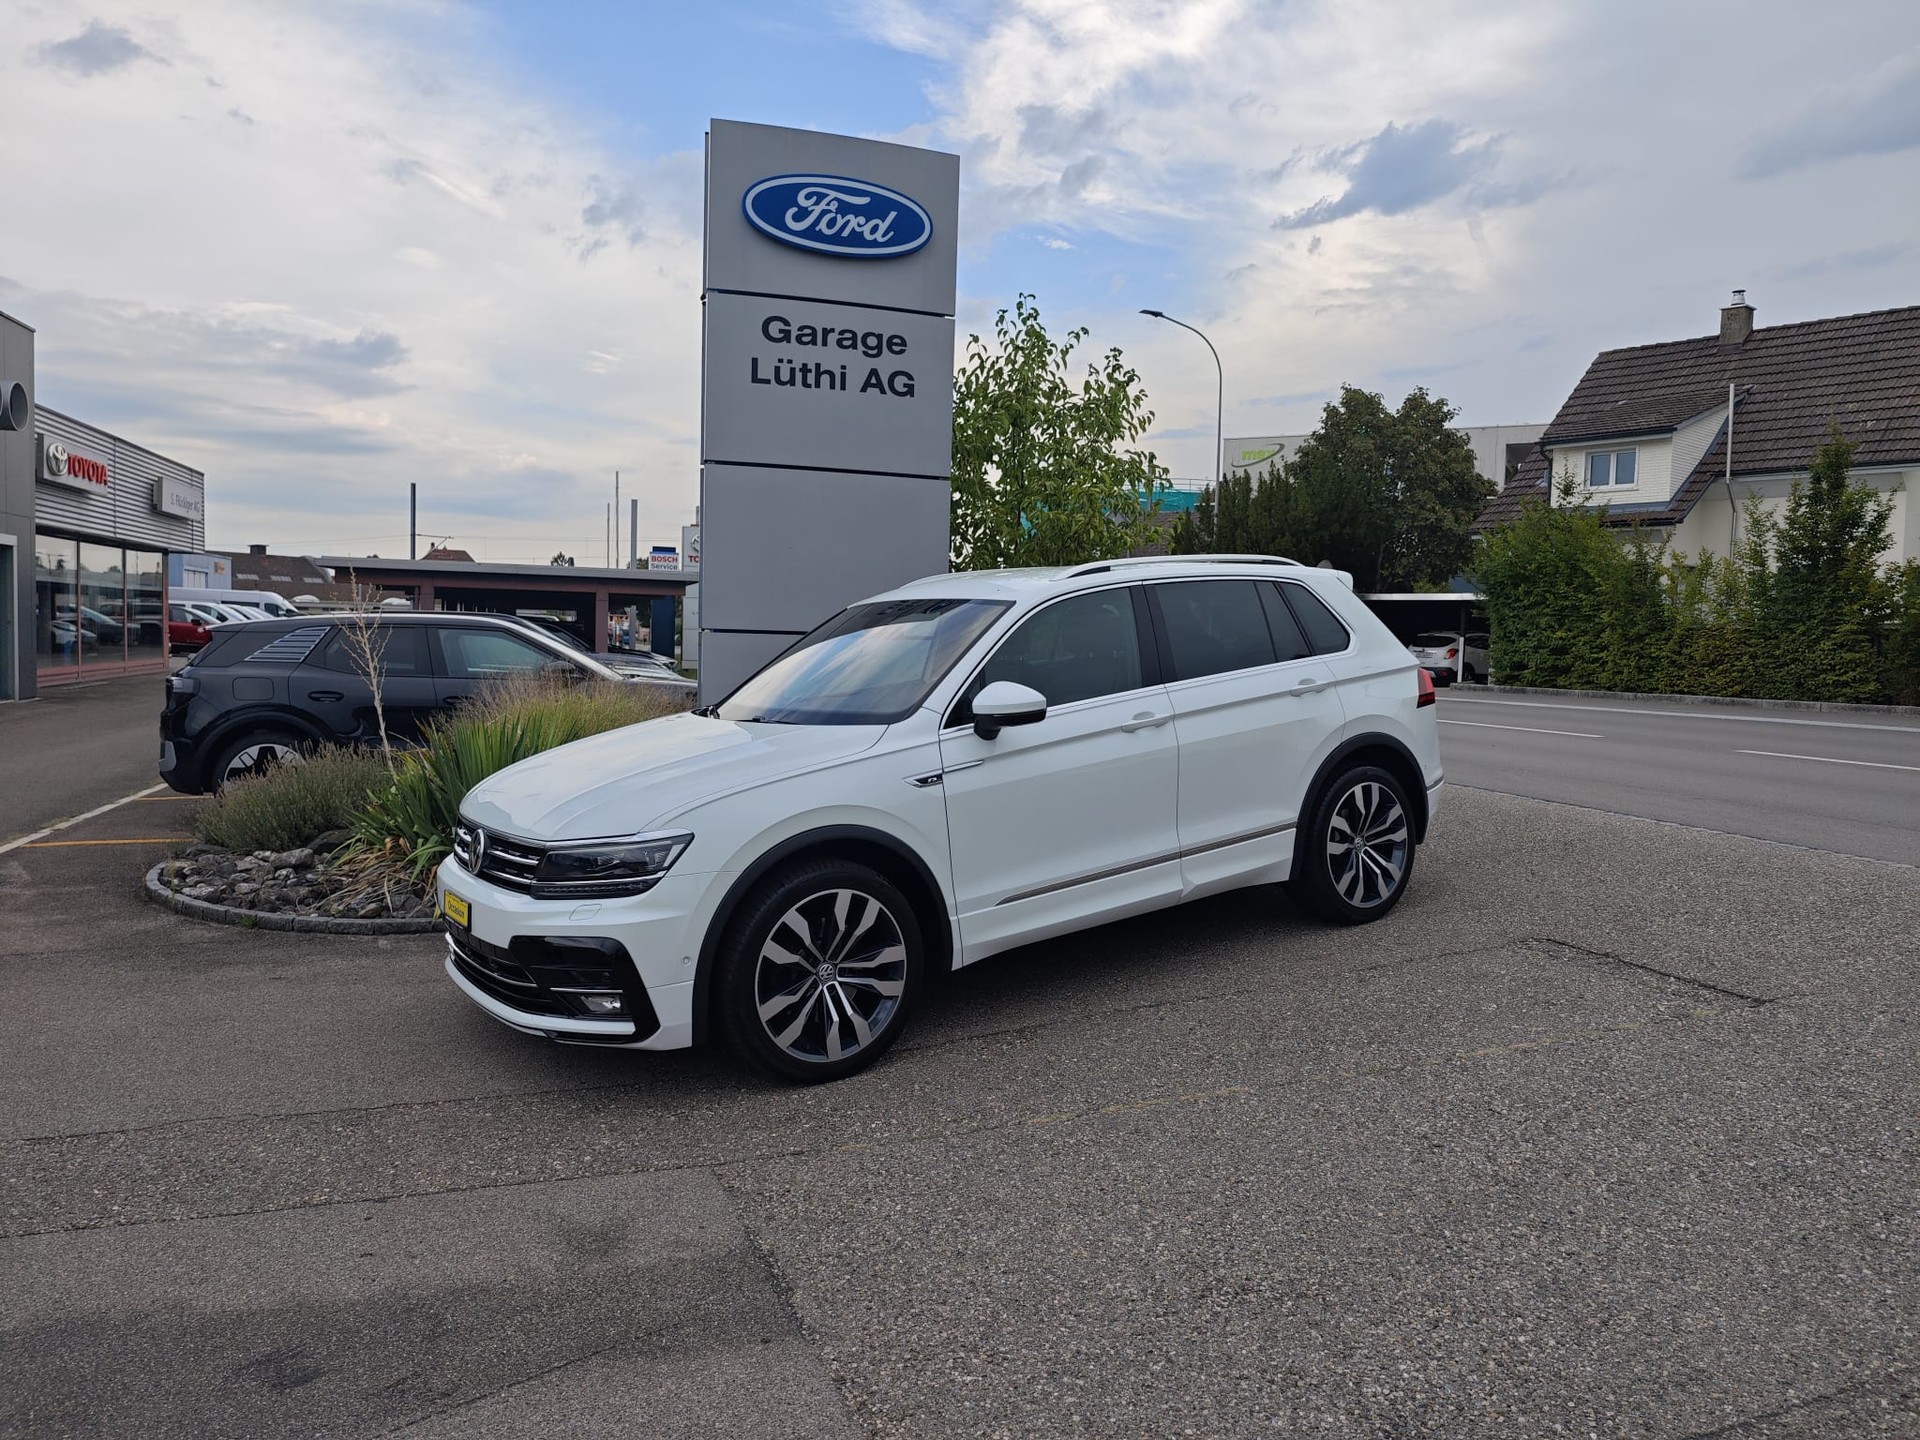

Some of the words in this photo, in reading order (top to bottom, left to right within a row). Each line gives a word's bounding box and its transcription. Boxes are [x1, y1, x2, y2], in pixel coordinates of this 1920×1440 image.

[785, 187, 898, 243] Ford
[761, 315, 908, 358] Garage
[751, 357, 847, 391] Lüthi
[859, 367, 915, 398] AG
[67, 453, 108, 486] TOYOTA
[651, 555, 678, 563] BOSCH
